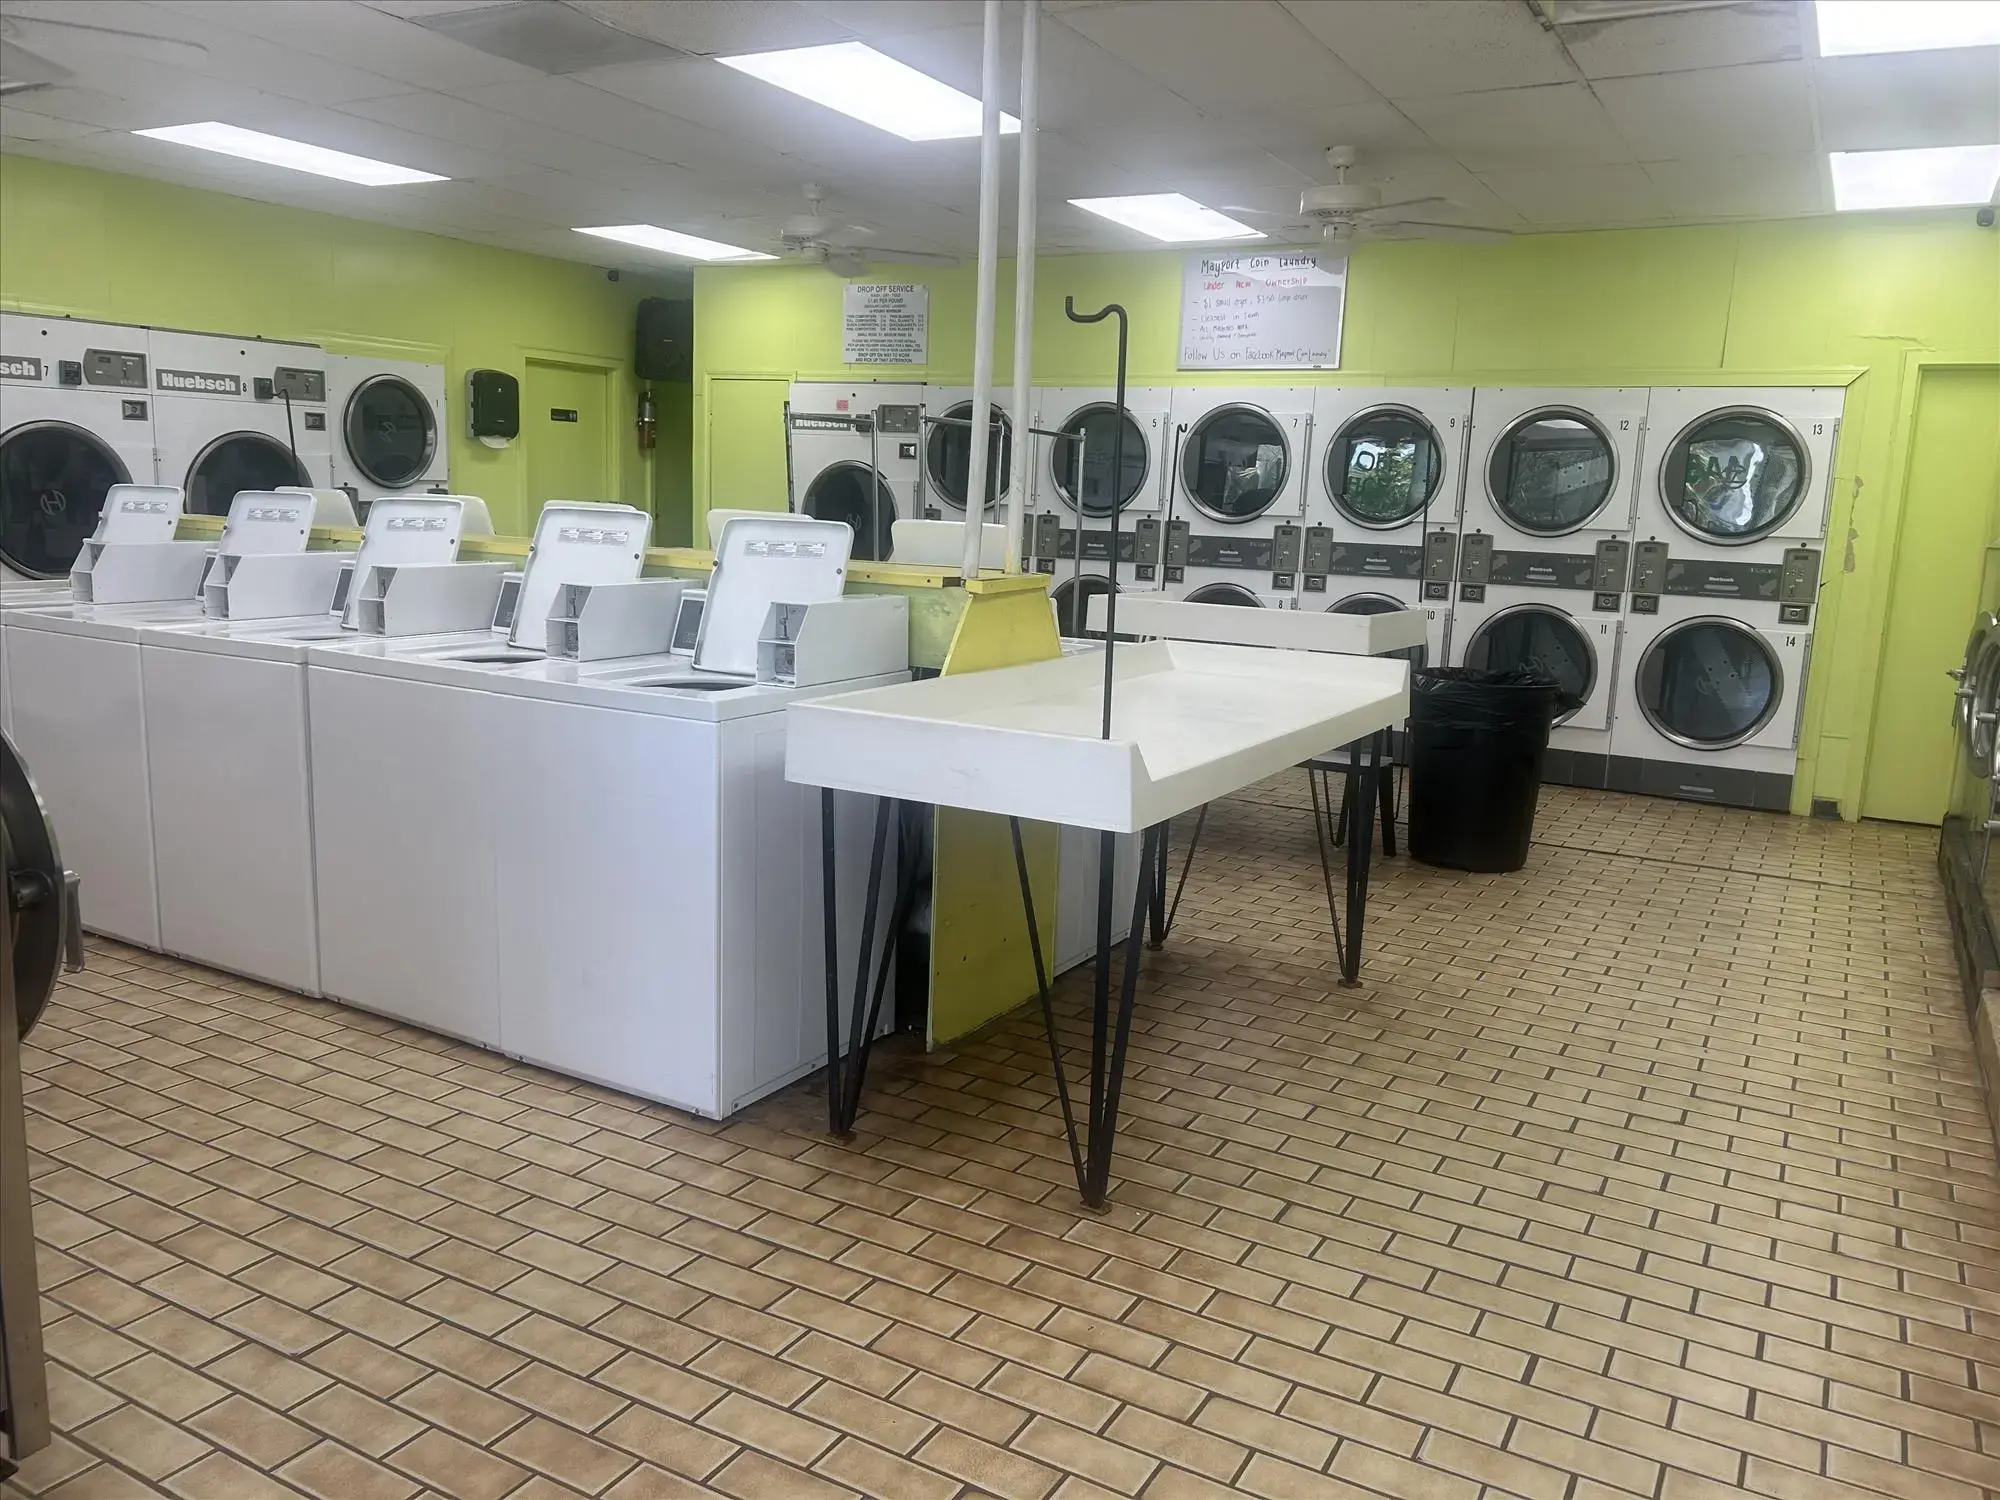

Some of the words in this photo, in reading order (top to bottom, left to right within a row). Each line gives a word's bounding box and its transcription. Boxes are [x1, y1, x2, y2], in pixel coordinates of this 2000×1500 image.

[1201, 258, 1239, 278] Mayport
[1251, 258, 1269, 268] Coin
[1280, 256, 1316, 268] Laundry
[1204, 281, 1224, 290] Under
[1213, 347, 1225, 360] Us
[44, 365, 48, 376] 7
[161, 373, 236, 391] Huebsch
[242, 382, 247, 392] 8
[1152, 418, 1156, 428] 5
[1294, 418, 1298, 428] 7
[1450, 418, 1455, 427] 9
[1620, 420, 1629, 431] 12
[1813, 424, 1823, 435] 13
[1278, 600, 1283, 609] 8
[1427, 610, 1435, 620] 10
[1600, 624, 1607, 634] 11
[1786, 636, 1796, 647] 14
